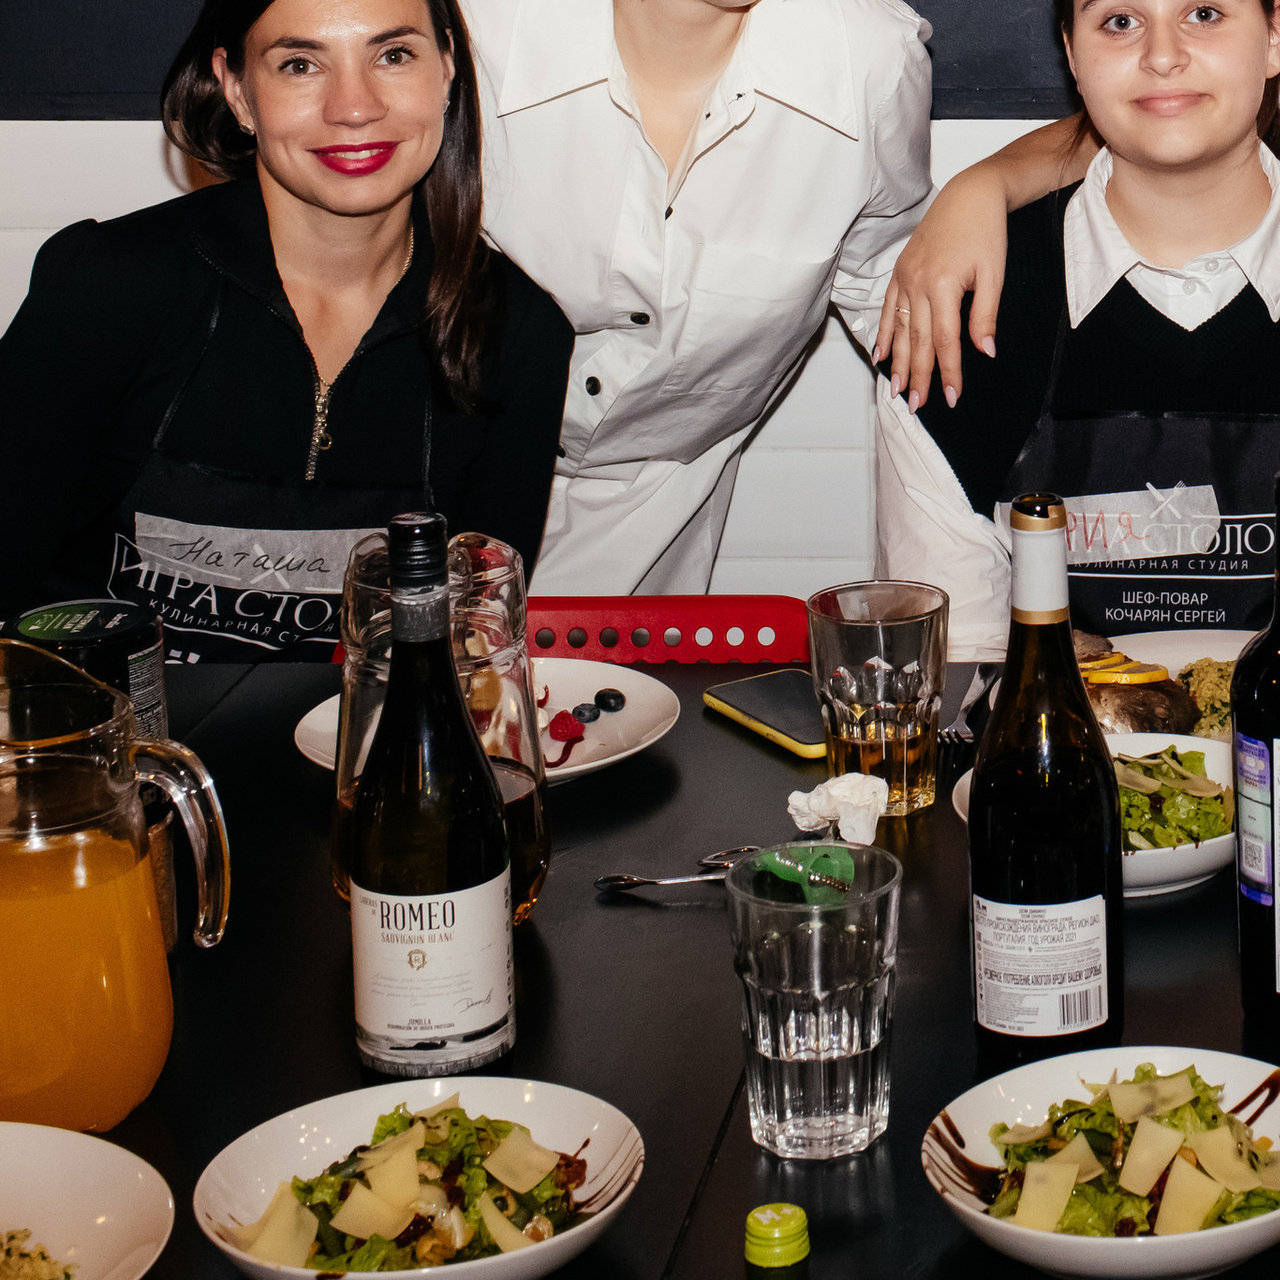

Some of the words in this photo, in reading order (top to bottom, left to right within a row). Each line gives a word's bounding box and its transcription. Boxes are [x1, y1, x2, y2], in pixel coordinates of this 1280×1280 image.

[169, 535, 331, 573] Наташа
[1074, 559, 1179, 570] КУЛИНАРНАЯ
[1188, 559, 1249, 572] СТУДИЯ
[120, 545, 220, 616] ИГРА
[234, 589, 342, 632] СТО
[1122, 591, 1208, 606] ШЕФ-ПОВАР
[149, 599, 273, 637] КУЛИНАРНАЯ
[1105, 608, 1171, 623] КОЧАРЯН
[1174, 607, 1226, 623] СЕРГЕЙ
[380, 900, 455, 931] ROMEO
[987, 919, 1032, 933] ПРОИСХОЖДЕНИЯ
[1068, 919, 1088, 930] РЕГИОН
[381, 932, 424, 944] SAUVIGNON
[428, 931, 454, 943] BLANC
[1028, 933, 1039, 945] ГОД
[1040, 933, 1064, 944] УРОЖАЯ
[1065, 932, 1076, 943] 2021
[1003, 972, 1030, 985] ПОТРЕБЛЕНИЕ
[1031, 973, 1051, 985] АЛКОГОЛЯ
[1052, 972, 1067, 984] ВРЕДИТ
[1068, 970, 1083, 983] ВАШЕМУ
[1084, 964, 1102, 980] ЗДОРОВЬЮ
